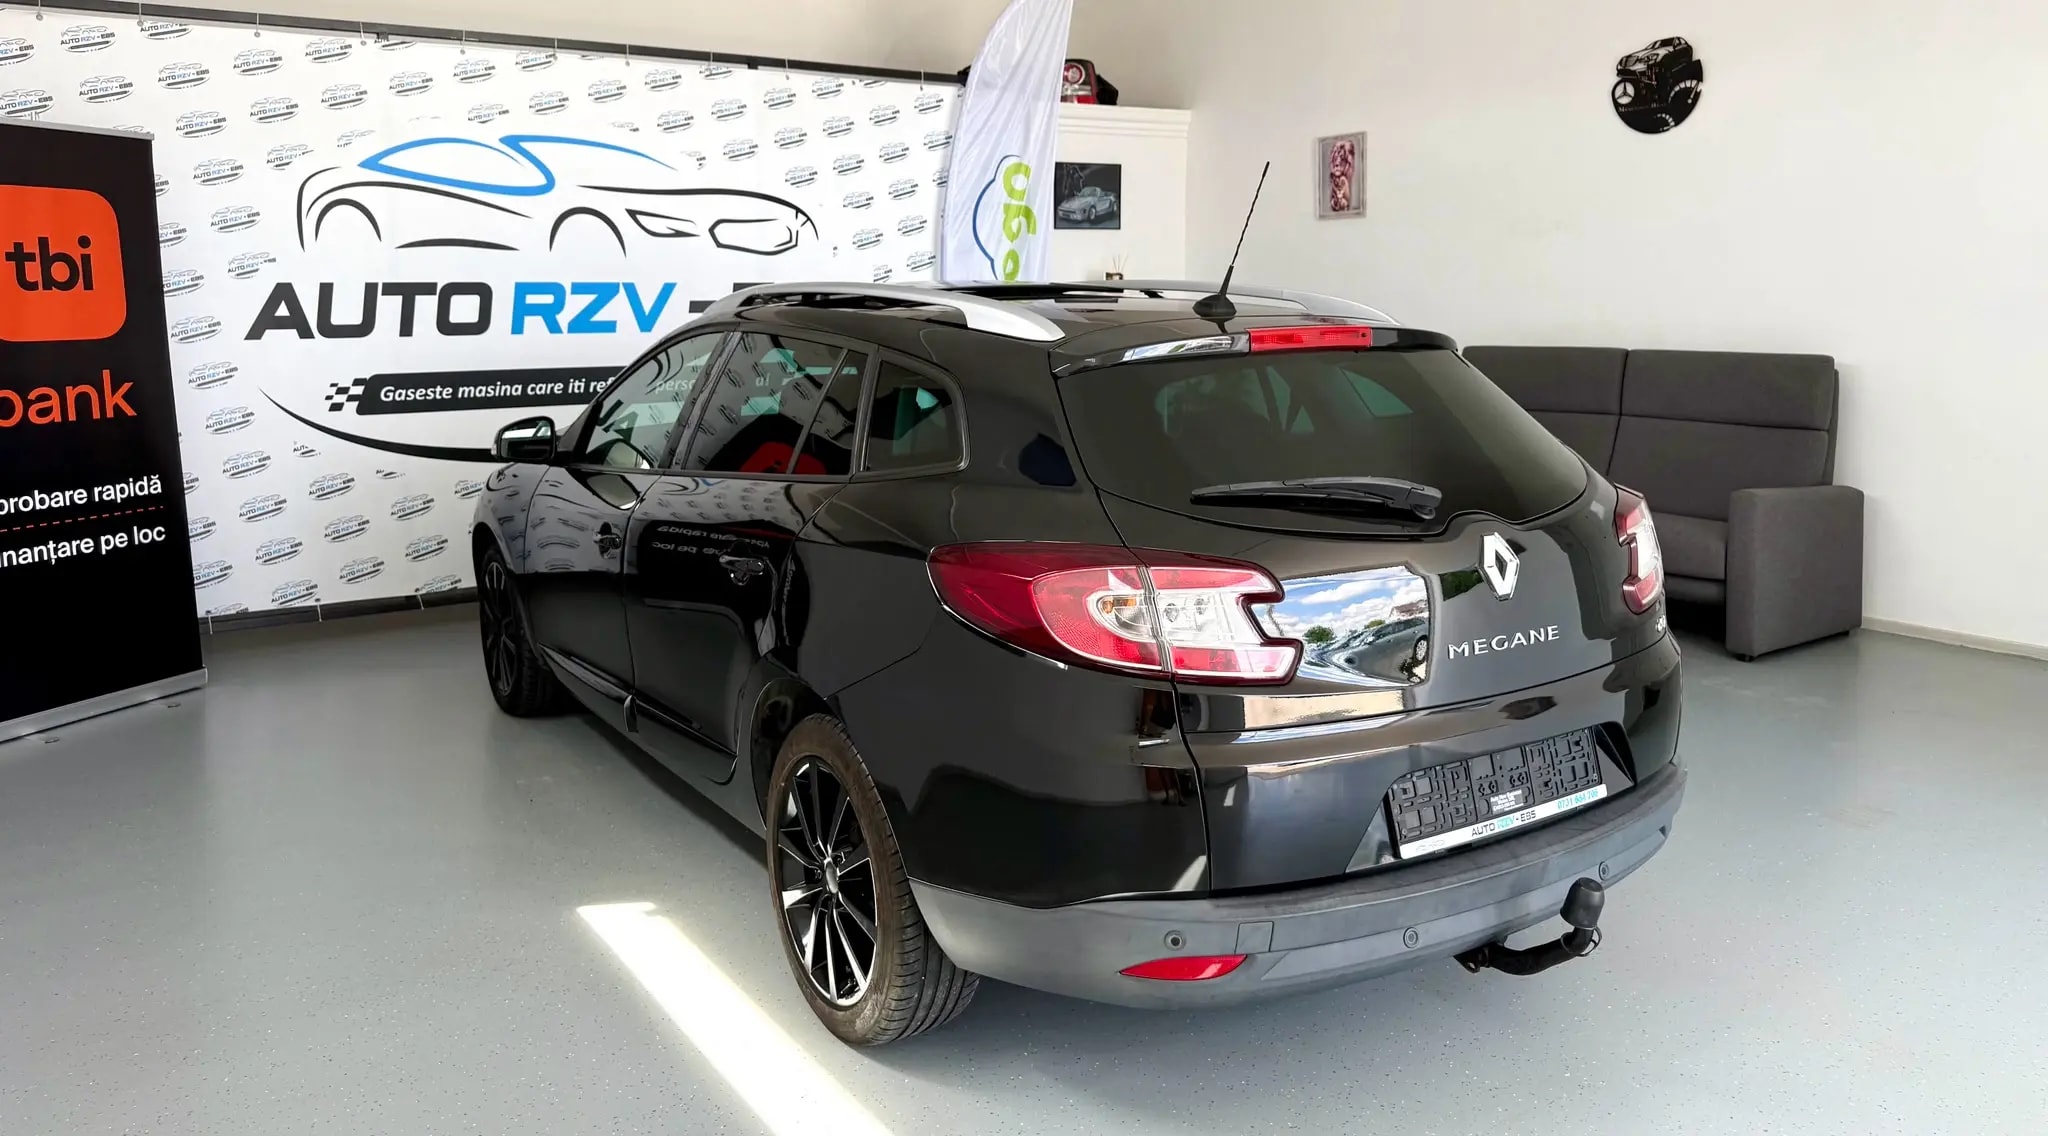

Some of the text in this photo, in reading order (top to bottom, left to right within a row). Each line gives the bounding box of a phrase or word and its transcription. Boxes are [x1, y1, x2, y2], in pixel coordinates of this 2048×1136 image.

[60, 37, 80, 46] AUTO
[233, 61, 251, 69] AUTO
[158, 74, 177, 82] AUTO
[79, 87, 99, 96] AUTO
[250, 108, 268, 117] AUTO
[175, 122, 194, 131] AUTO
[193, 170, 212, 179] AUTO
[210, 217, 229, 227] AUTO
[5, 235, 94, 291] tbi
[244, 282, 492, 340] AUTO
[510, 282, 677, 334] RZV
[171, 328, 189, 338] AUTO
[188, 374, 207, 384] AUTO
[380, 385, 453, 402] Gaseste
[458, 382, 521, 398] masina
[527, 383, 563, 396] care
[568, 378, 586, 393] iti
[205, 419, 224, 429] AUTO
[222, 464, 240, 474] AUTO
[94, 474, 162, 503] rapidă
[308, 486, 326, 496] AUTO
[238, 507, 257, 518] AUTO
[324, 528, 341, 538] AUTO
[0, 526, 166, 568] nanțare pe loc
[255, 550, 273, 561] AUTO
[271, 593, 289, 604] AUTO
[1448, 625, 1560, 660] MEGANE
[1472, 822, 1495, 837] AUTO
